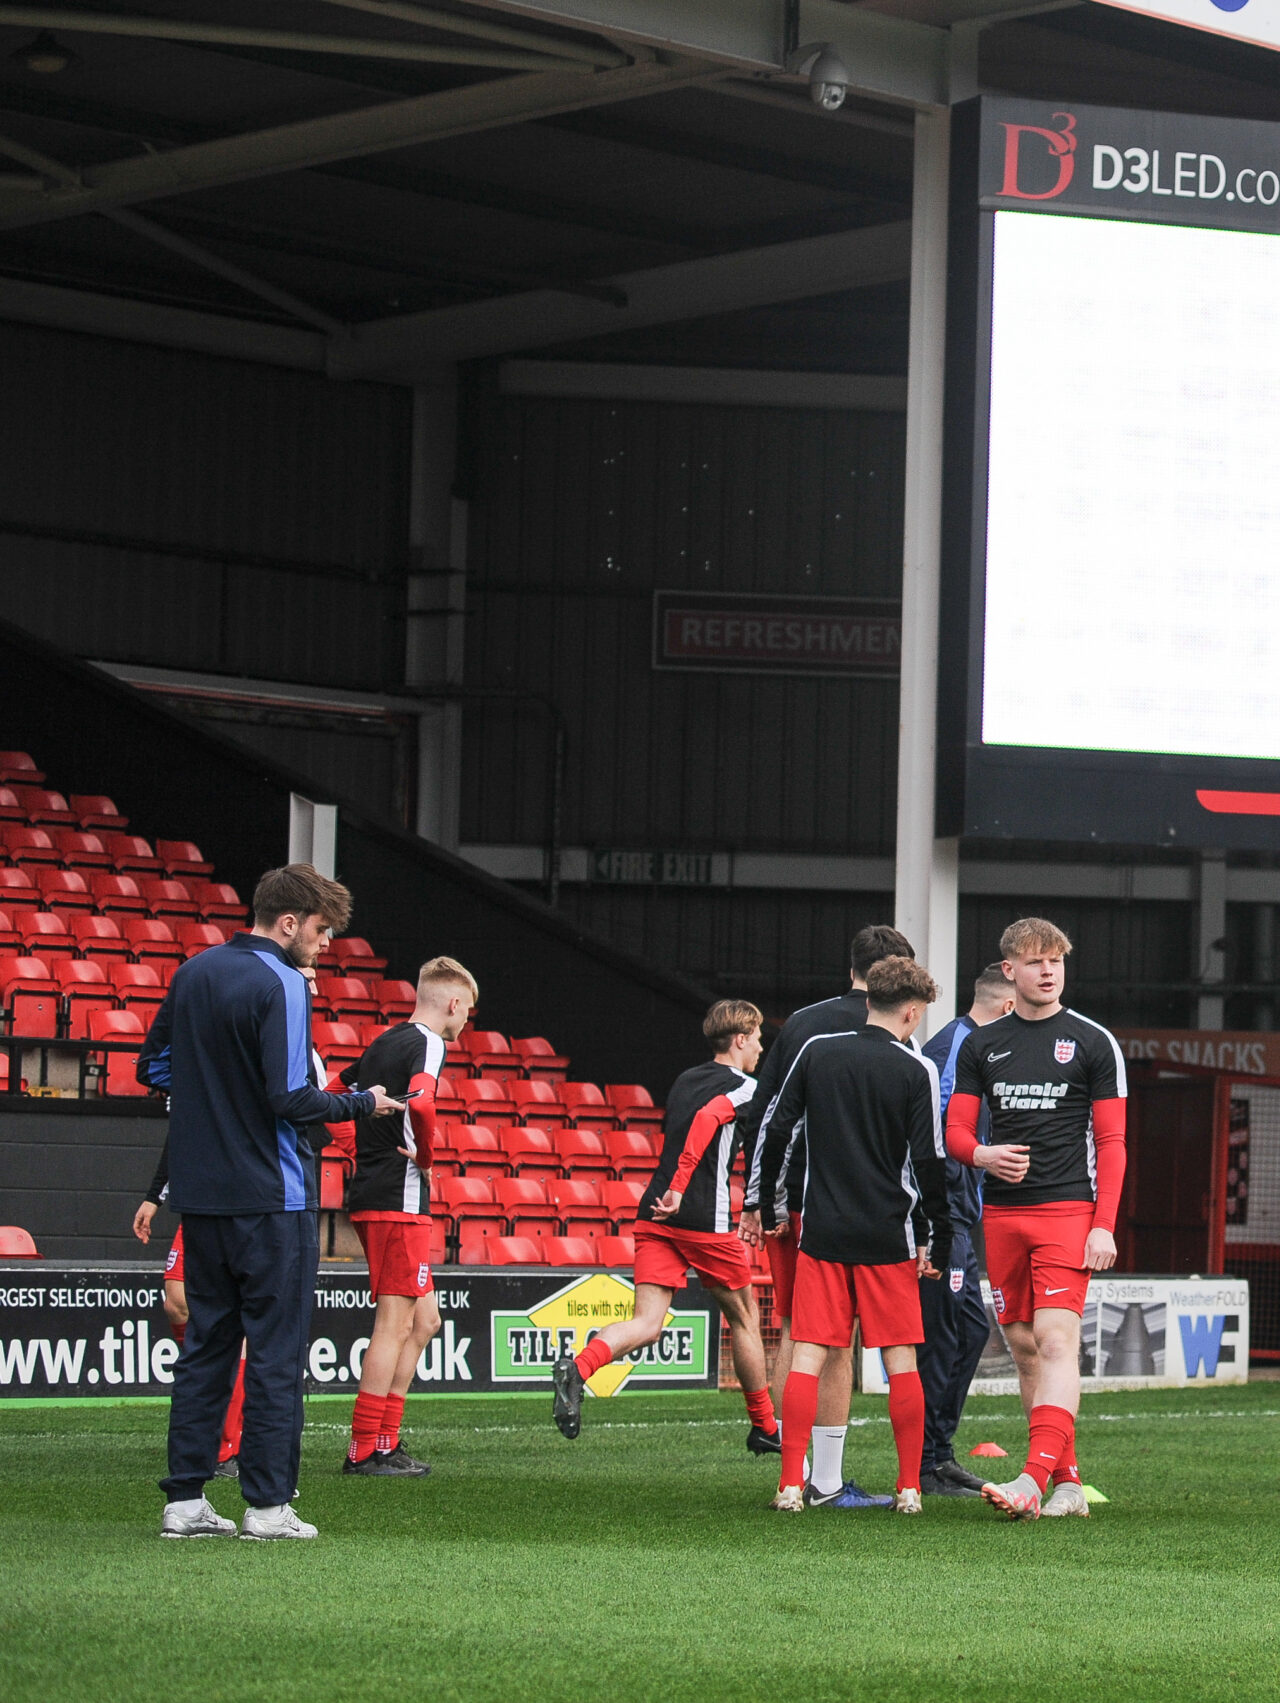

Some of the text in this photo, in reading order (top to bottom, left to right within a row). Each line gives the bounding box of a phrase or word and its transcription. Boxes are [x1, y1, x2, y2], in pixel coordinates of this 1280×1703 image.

[663, 854, 711, 885] EXIT
[993, 1082, 1069, 1098] Arnold
[1000, 1096, 1060, 1110] Clark
[49, 1289, 133, 1307] SELECTION
[136, 1289, 158, 1307] OF
[449, 1290, 470, 1309] UK
[1107, 1283, 1154, 1302] Systems
[567, 1299, 588, 1316] tiles
[590, 1299, 612, 1316] with
[508, 1328, 576, 1366] TILE
